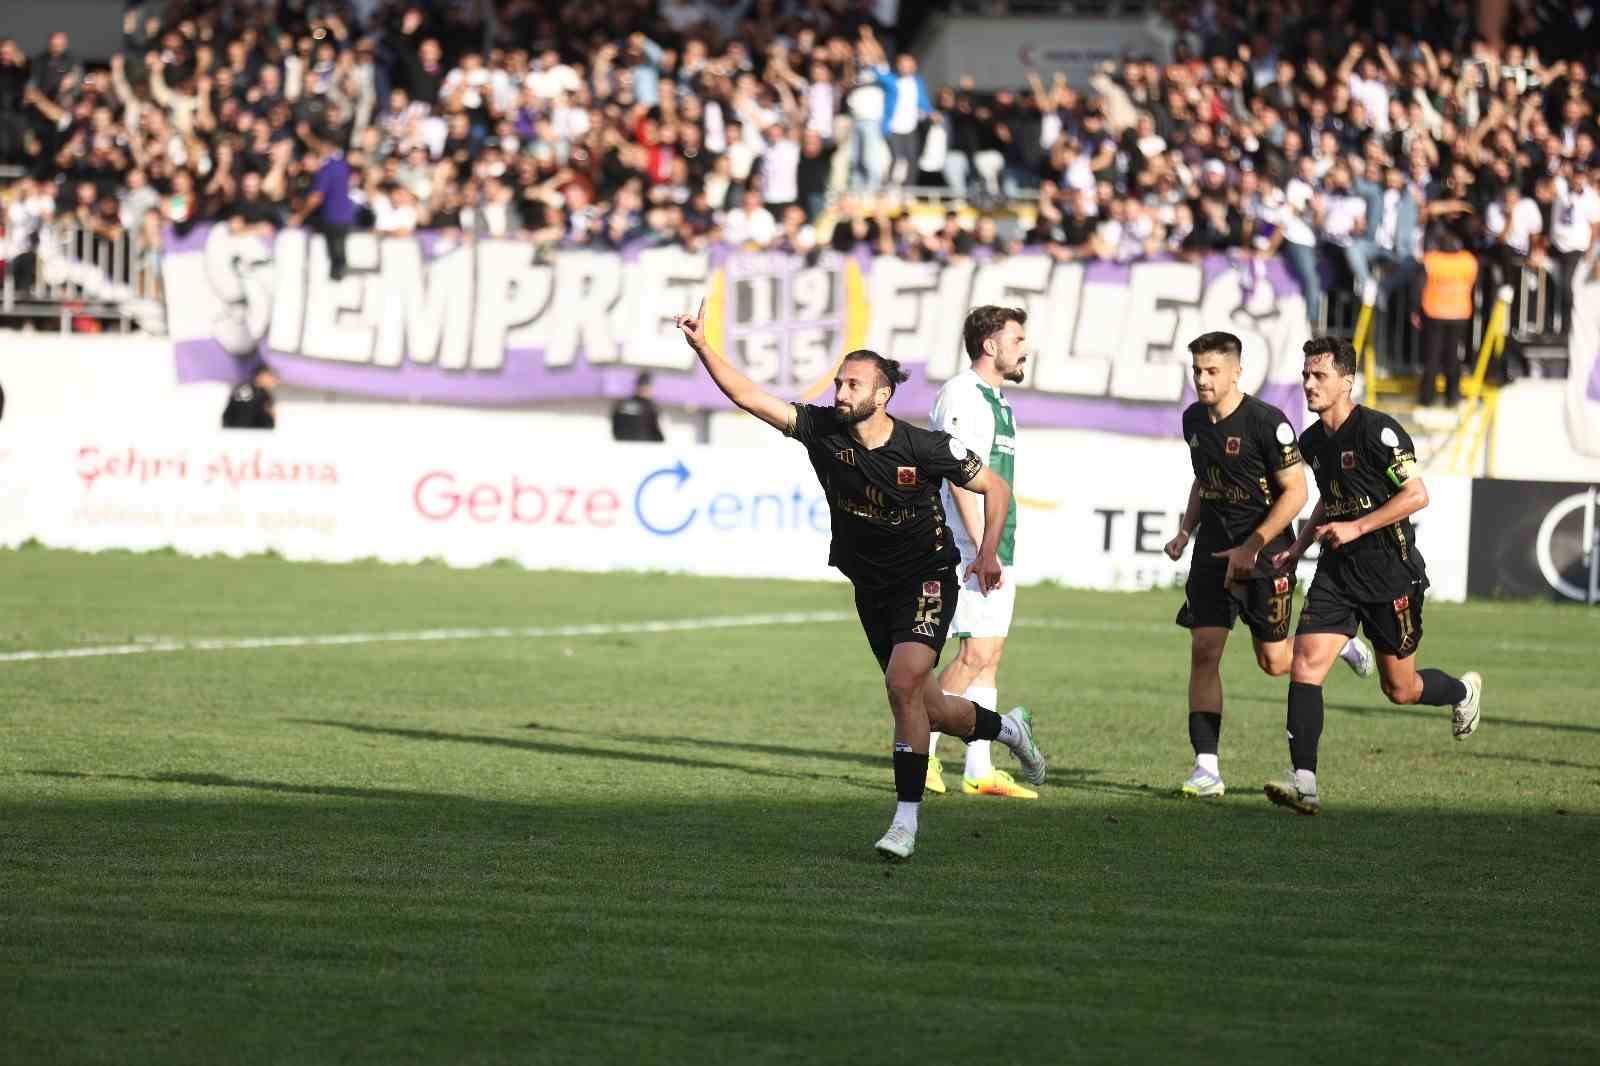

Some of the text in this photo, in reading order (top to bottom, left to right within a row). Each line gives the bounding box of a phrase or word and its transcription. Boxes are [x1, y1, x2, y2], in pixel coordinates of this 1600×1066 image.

[203, 221, 706, 371] SIEMPRE
[203, 447, 337, 489] Adana
[413, 469, 621, 527] Gebze
[634, 461, 831, 536] Cente
[914, 596, 943, 626] 12
